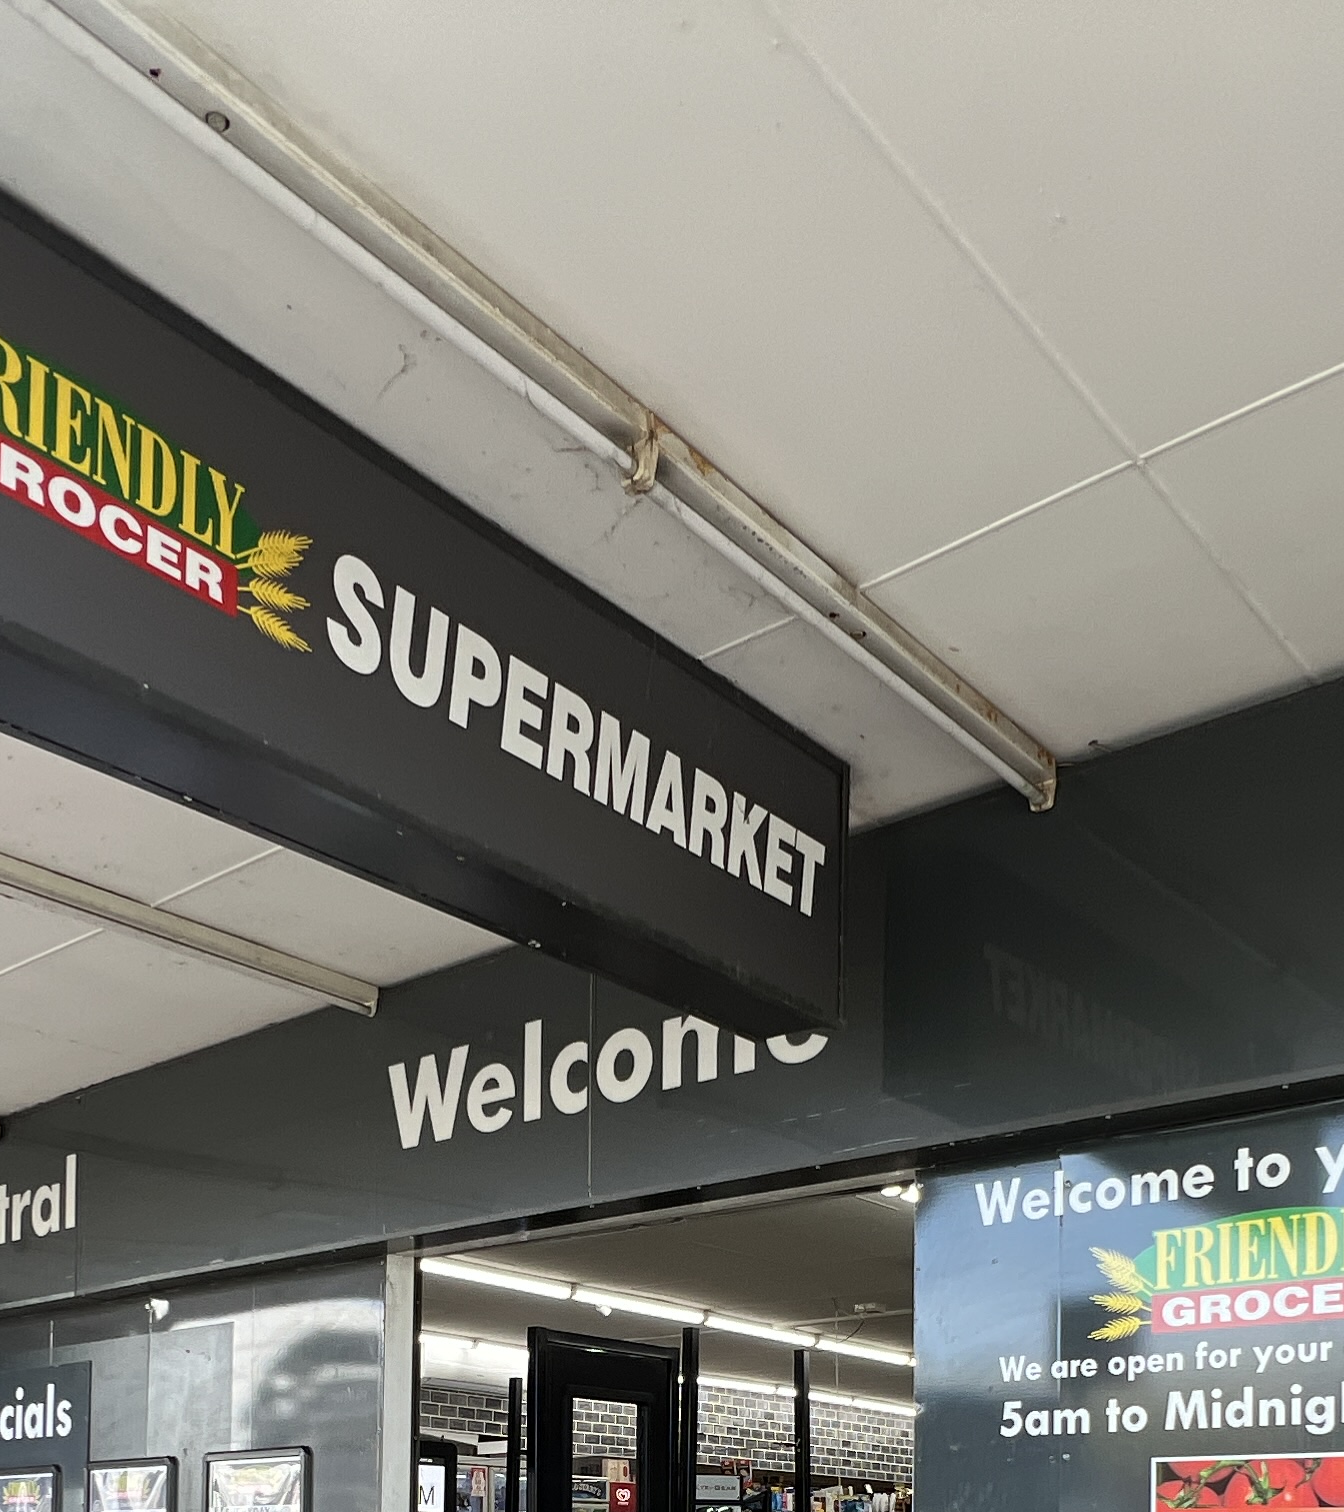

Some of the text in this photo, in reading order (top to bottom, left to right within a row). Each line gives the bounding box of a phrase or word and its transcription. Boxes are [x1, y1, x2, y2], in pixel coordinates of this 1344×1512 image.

[326, 553, 826, 918] SUPERMARKET
[975, 1160, 1215, 1226] Welcome
[1234, 1147, 1291, 1194] to
[999, 1355, 1043, 1384] We
[1052, 1352, 1098, 1380] are
[1107, 1350, 1185, 1382] open
[1195, 1339, 1247, 1371] for
[1253, 1336, 1332, 1373] your
[1000, 1400, 1091, 1438] 5am
[1106, 1396, 1148, 1434] to
